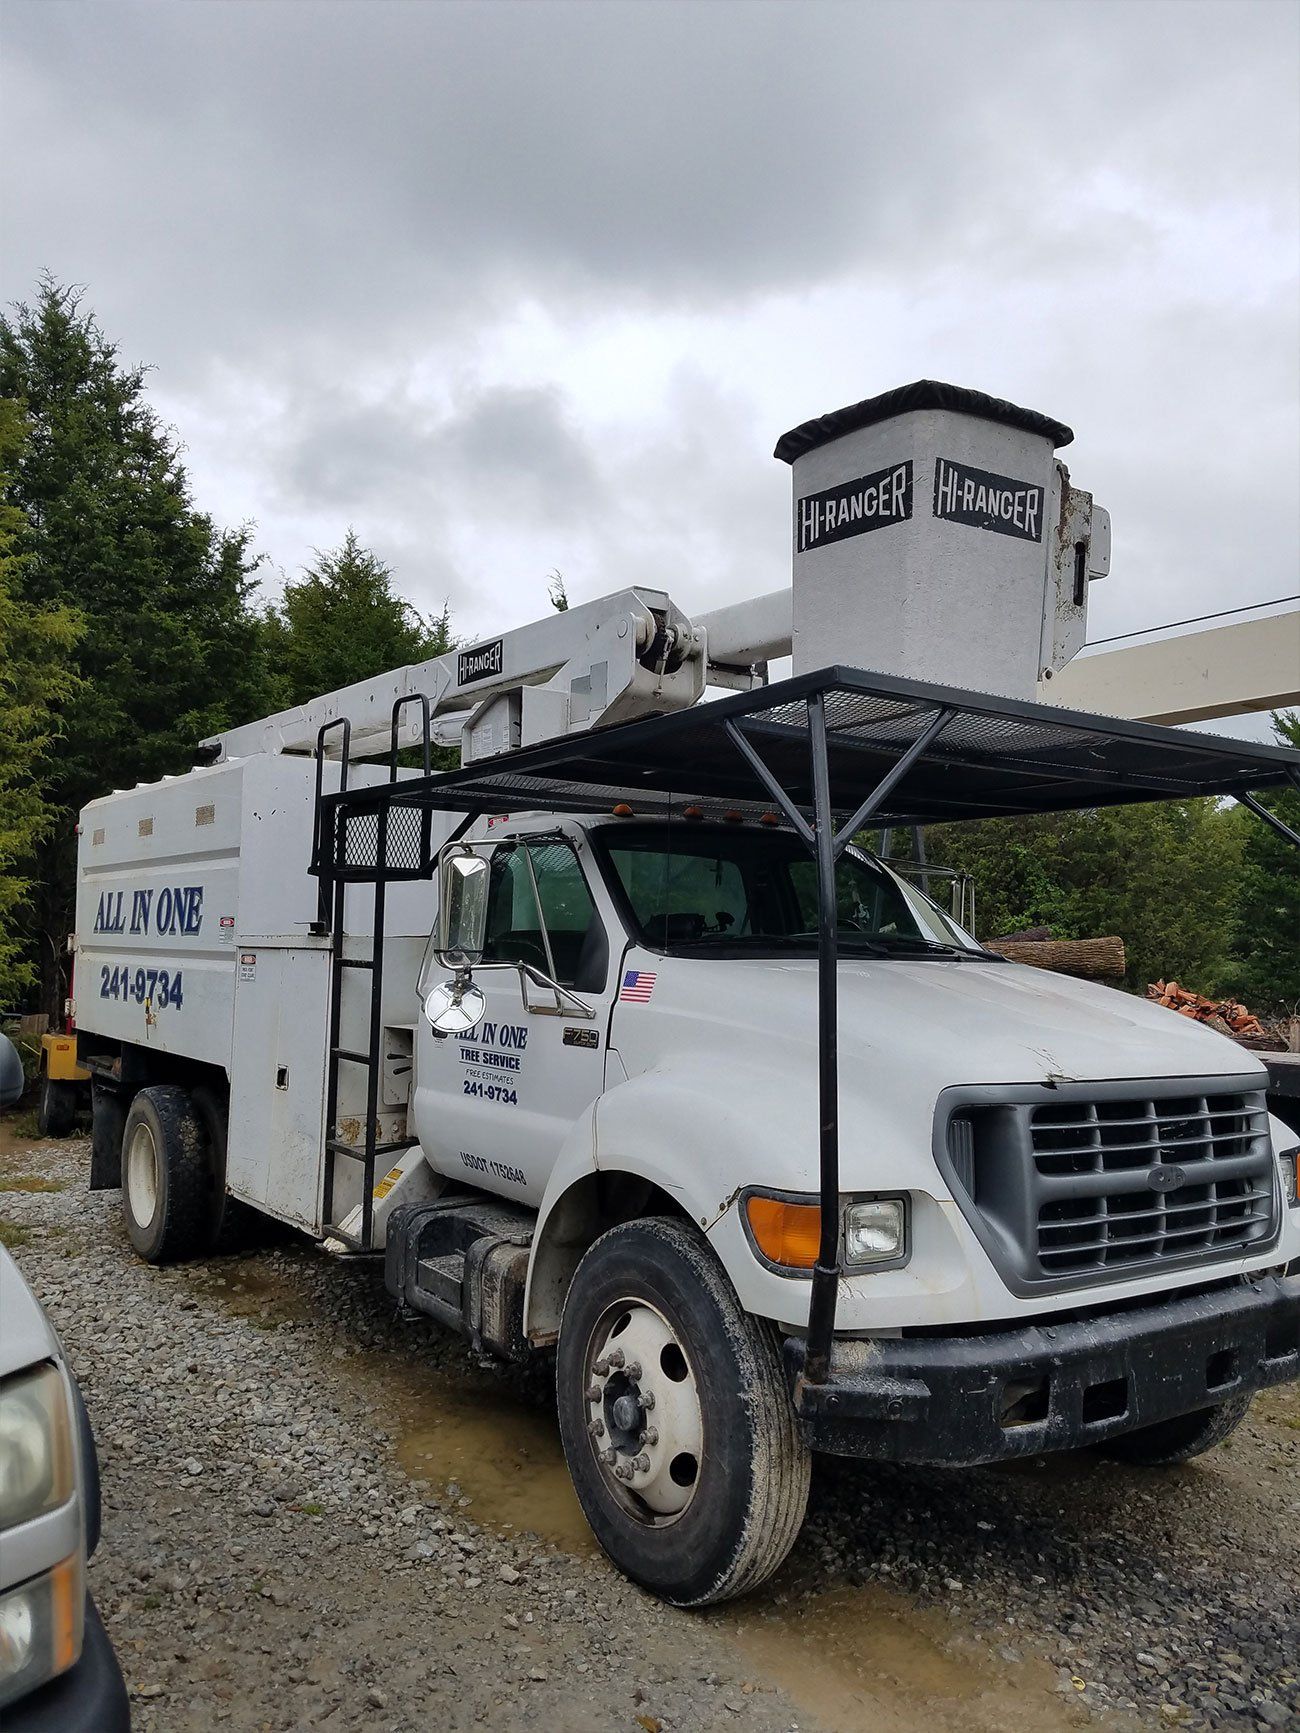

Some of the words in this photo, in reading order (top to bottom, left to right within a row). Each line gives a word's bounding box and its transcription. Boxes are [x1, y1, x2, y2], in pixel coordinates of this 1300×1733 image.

[801, 464, 907, 550] HI-RANGER
[937, 459, 1039, 539] HI-RANGER
[459, 642, 501, 685] HI-RANGER
[93, 890, 127, 935] ALL
[129, 888, 154, 936] IN
[156, 886, 204, 936] ONE
[100, 964, 183, 1011] 241-9734
[481, 1022, 498, 1046] IN
[500, 1024, 528, 1050] ONE
[564, 1028, 598, 1043] F750
[460, 1048, 480, 1063] TREE
[482, 1052, 521, 1071] SERVICE
[465, 1068, 481, 1079] FREE
[482, 1071, 514, 1086] ESTIMATES
[463, 1080, 518, 1105] 241-9734
[460, 1152, 489, 1173] USDOT
